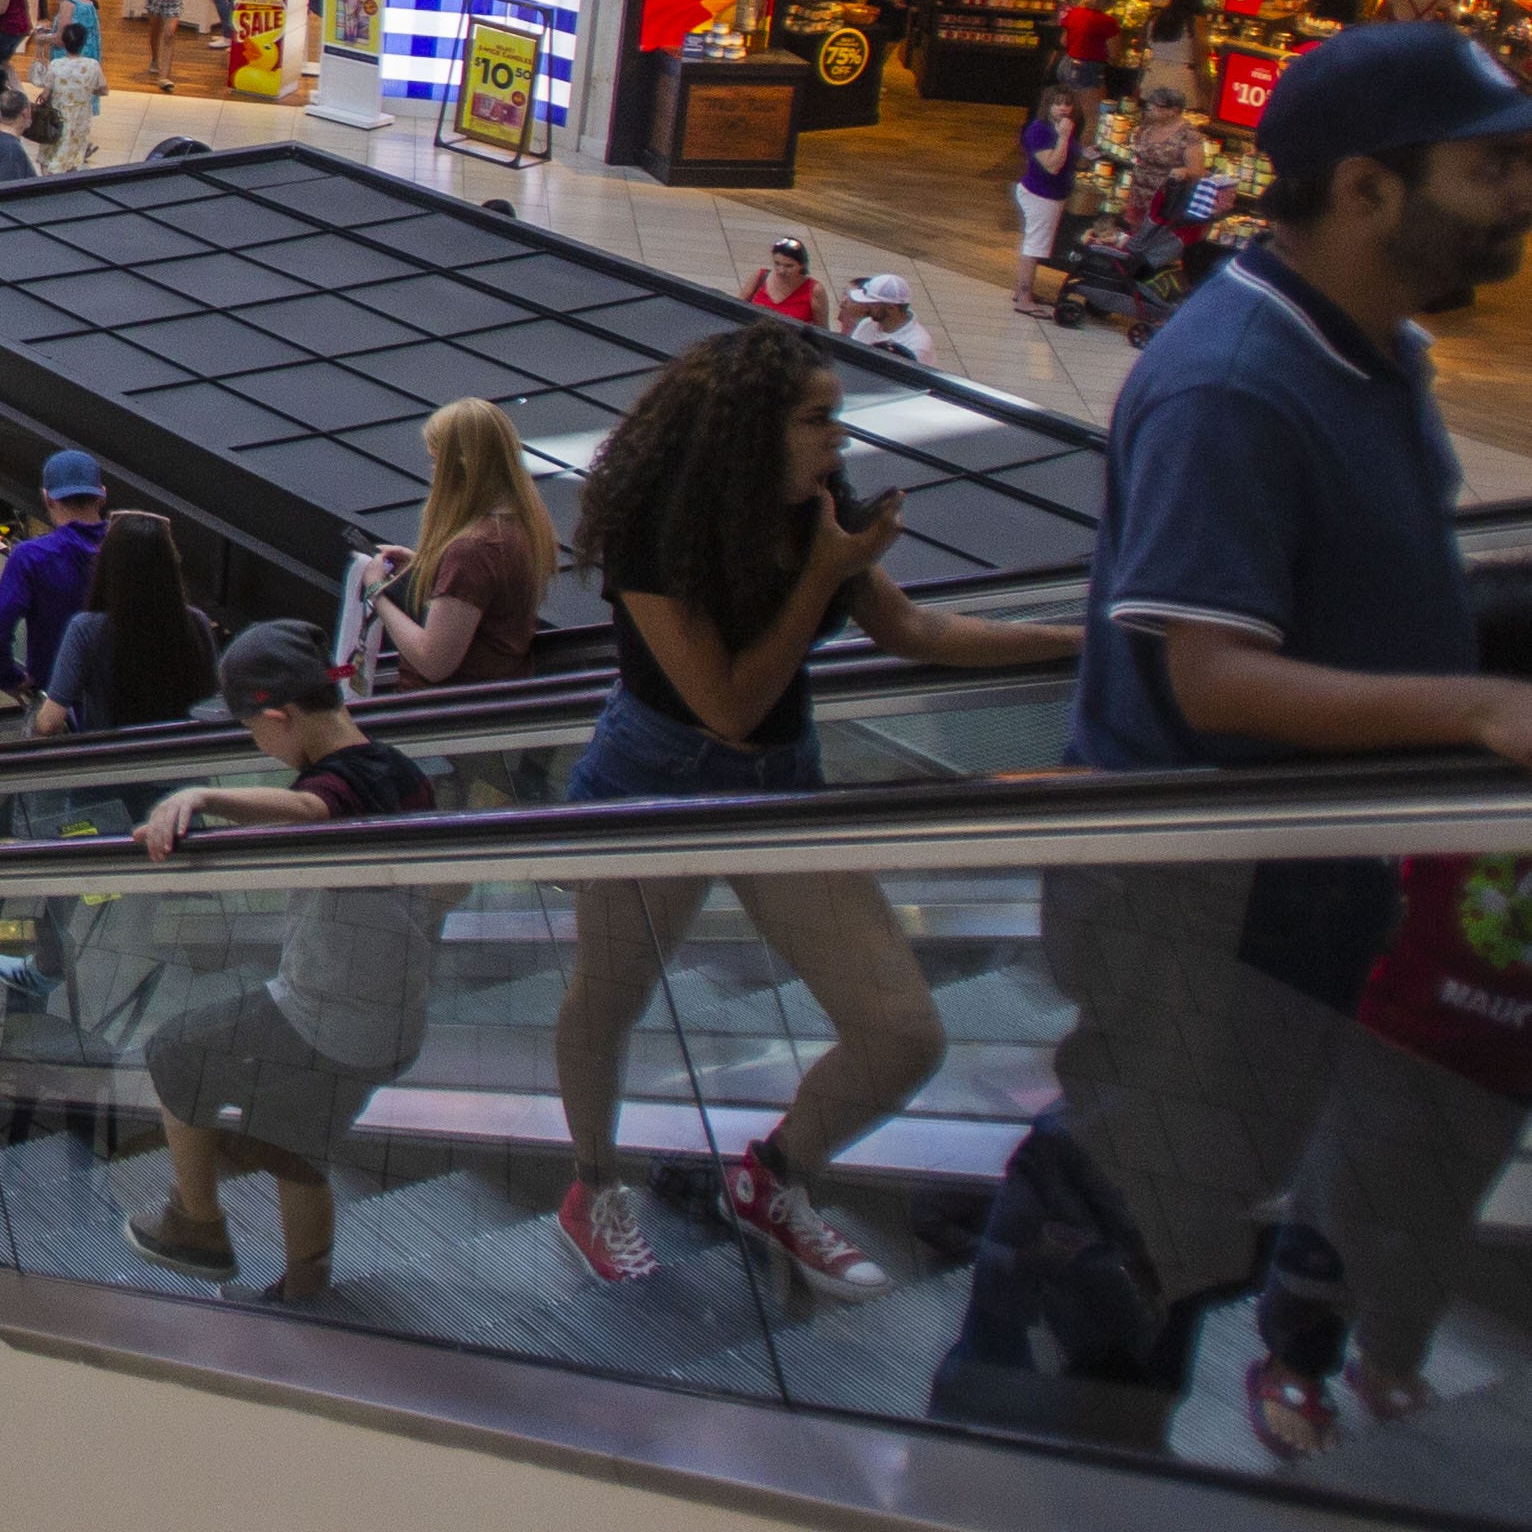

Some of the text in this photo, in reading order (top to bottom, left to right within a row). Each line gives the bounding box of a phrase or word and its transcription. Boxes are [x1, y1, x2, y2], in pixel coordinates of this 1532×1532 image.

[239, 11, 283, 41] SALE
[825, 46, 863, 65] 75%
[831, 65, 851, 75] OFF
